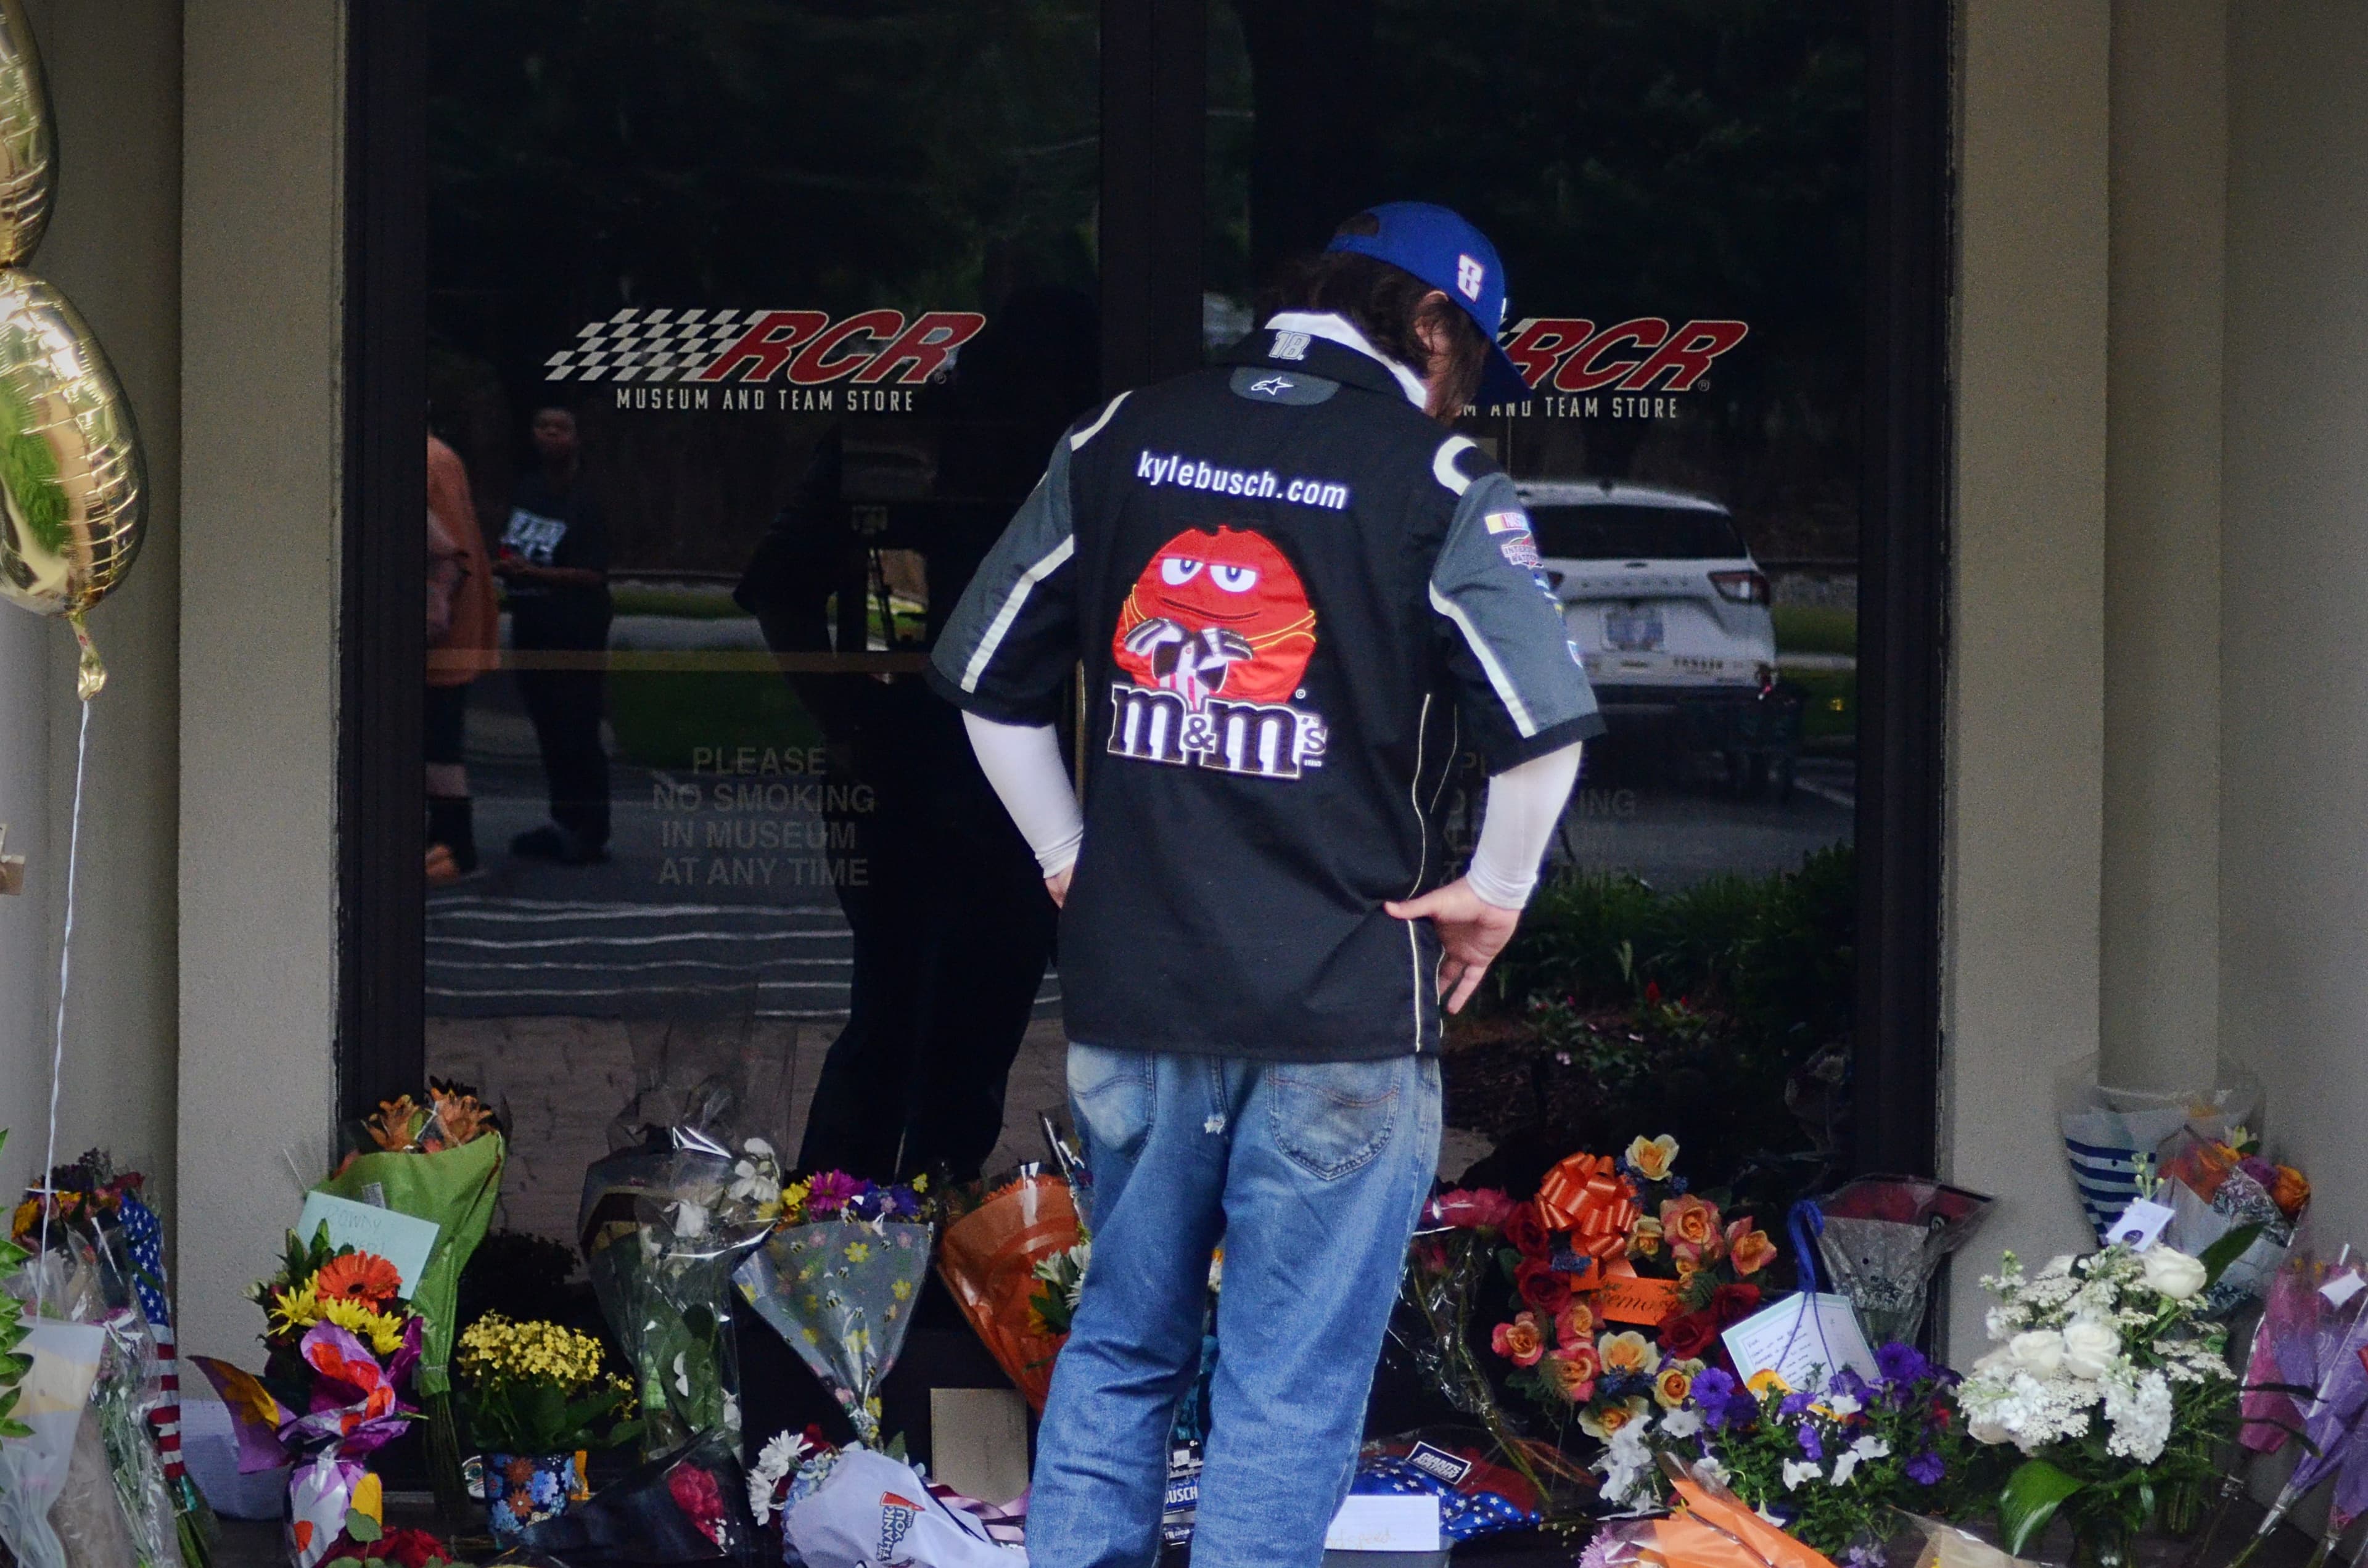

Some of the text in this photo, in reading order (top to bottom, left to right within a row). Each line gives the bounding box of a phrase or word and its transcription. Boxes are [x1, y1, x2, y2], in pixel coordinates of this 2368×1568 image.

[1457, 253, 1482, 302] 8
[694, 310, 986, 384] RCR
[1268, 330, 1310, 360] 18
[1503, 317, 1749, 391] RCR
[617, 388, 913, 412] MUSEUM AND TEAM STORE
[1545, 396, 1598, 417] TEAM
[1612, 397, 1677, 419] STORE
[1137, 451, 1349, 510] kylebusch.com
[693, 747, 828, 775] PLEASE
[652, 784, 876, 813] NO SMOKING
[662, 821, 856, 849] IN MUSEUM
[659, 858, 869, 886] AT ANY TIME
[883, 1508, 895, 1558] THANK
[895, 1510, 906, 1540] YOU
